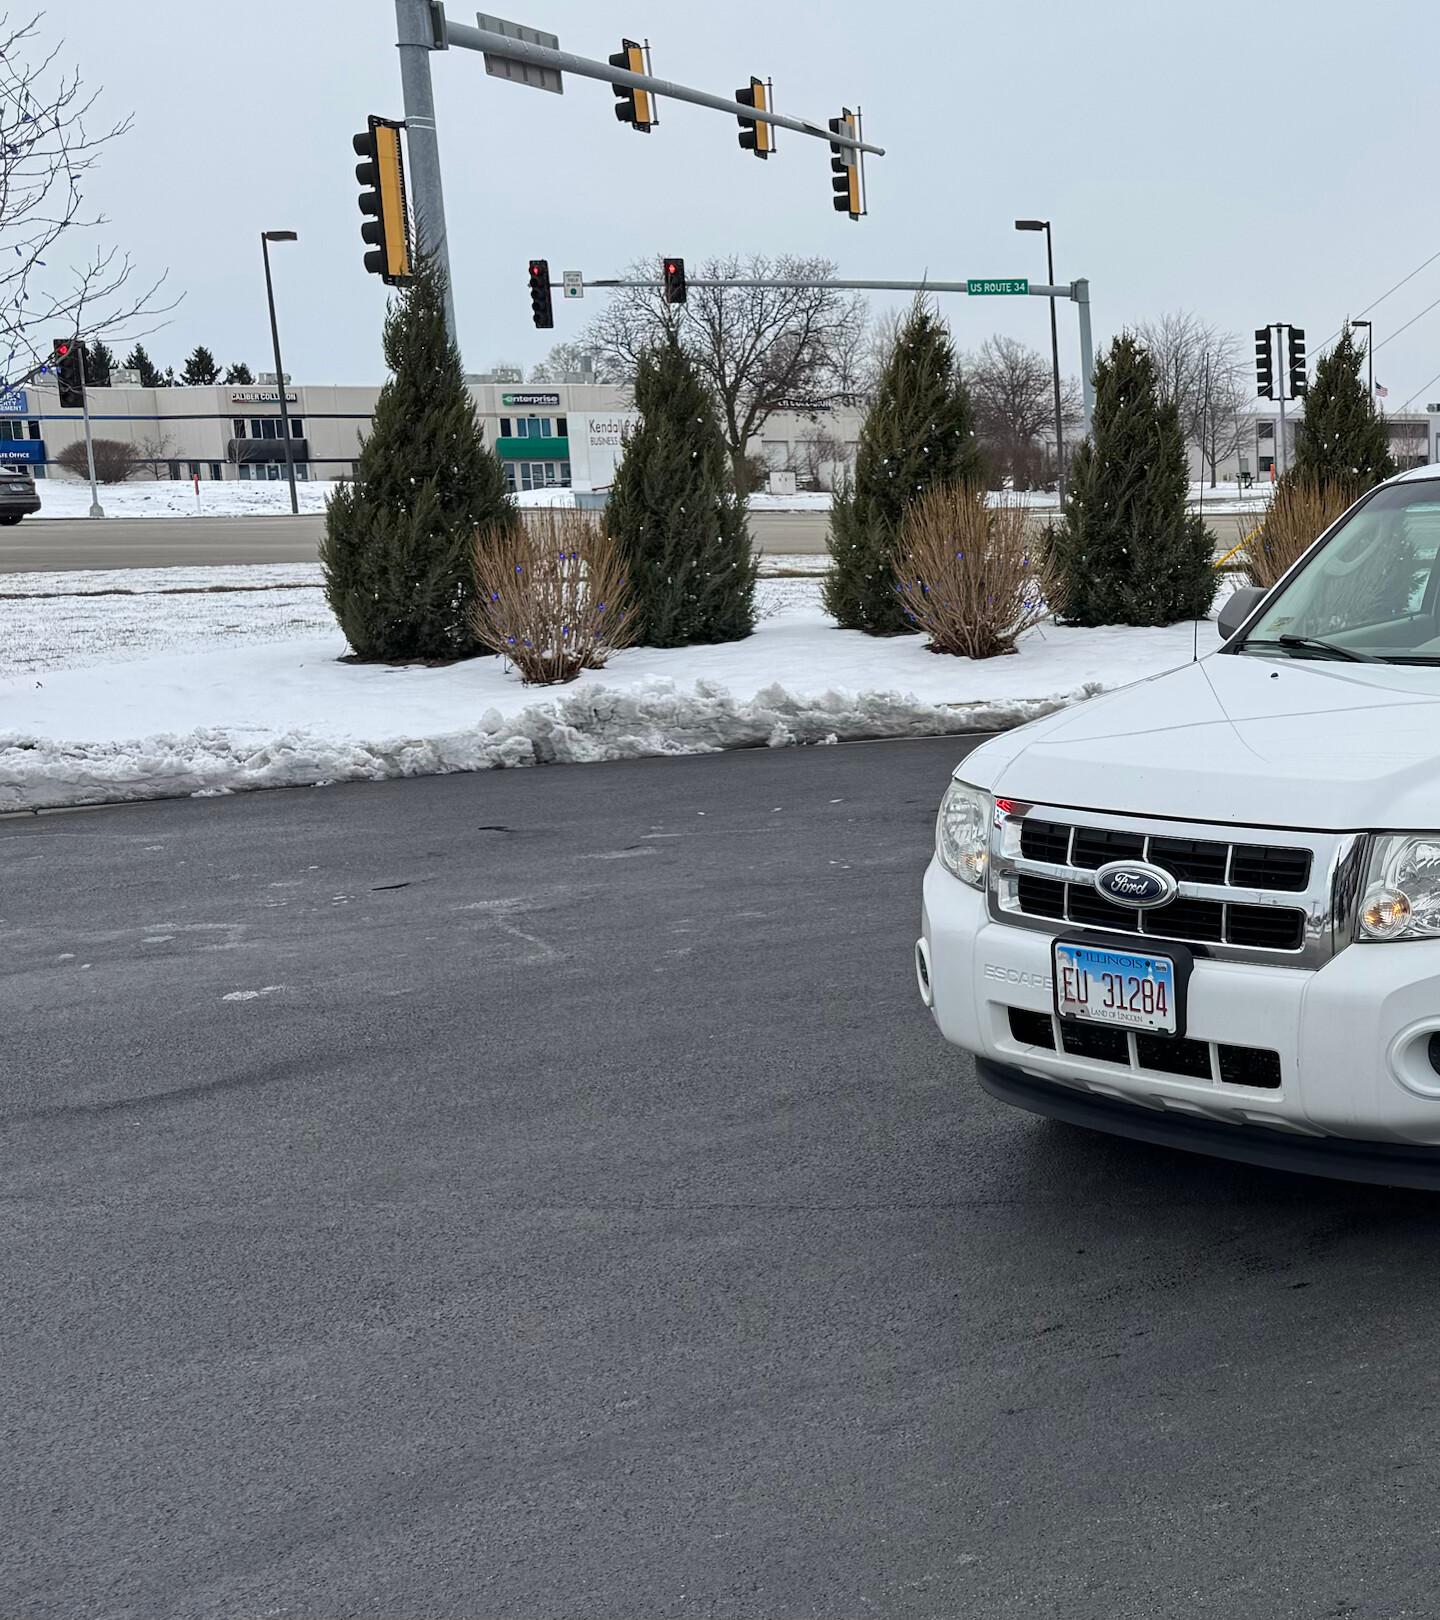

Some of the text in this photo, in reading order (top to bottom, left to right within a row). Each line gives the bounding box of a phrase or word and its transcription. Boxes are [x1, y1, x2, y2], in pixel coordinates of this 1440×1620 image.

[970, 283, 1025, 292] US ROUTE 34
[504, 394, 558, 403] enterprise
[589, 418, 622, 433] Kendall
[590, 436, 618, 446] BUSINESS
[1111, 873, 1149, 895] Ford
[1085, 952, 1143, 969] ILLINOIS
[984, 963, 1053, 992] ESCAPE
[1063, 966, 1168, 1017] EU 31284
